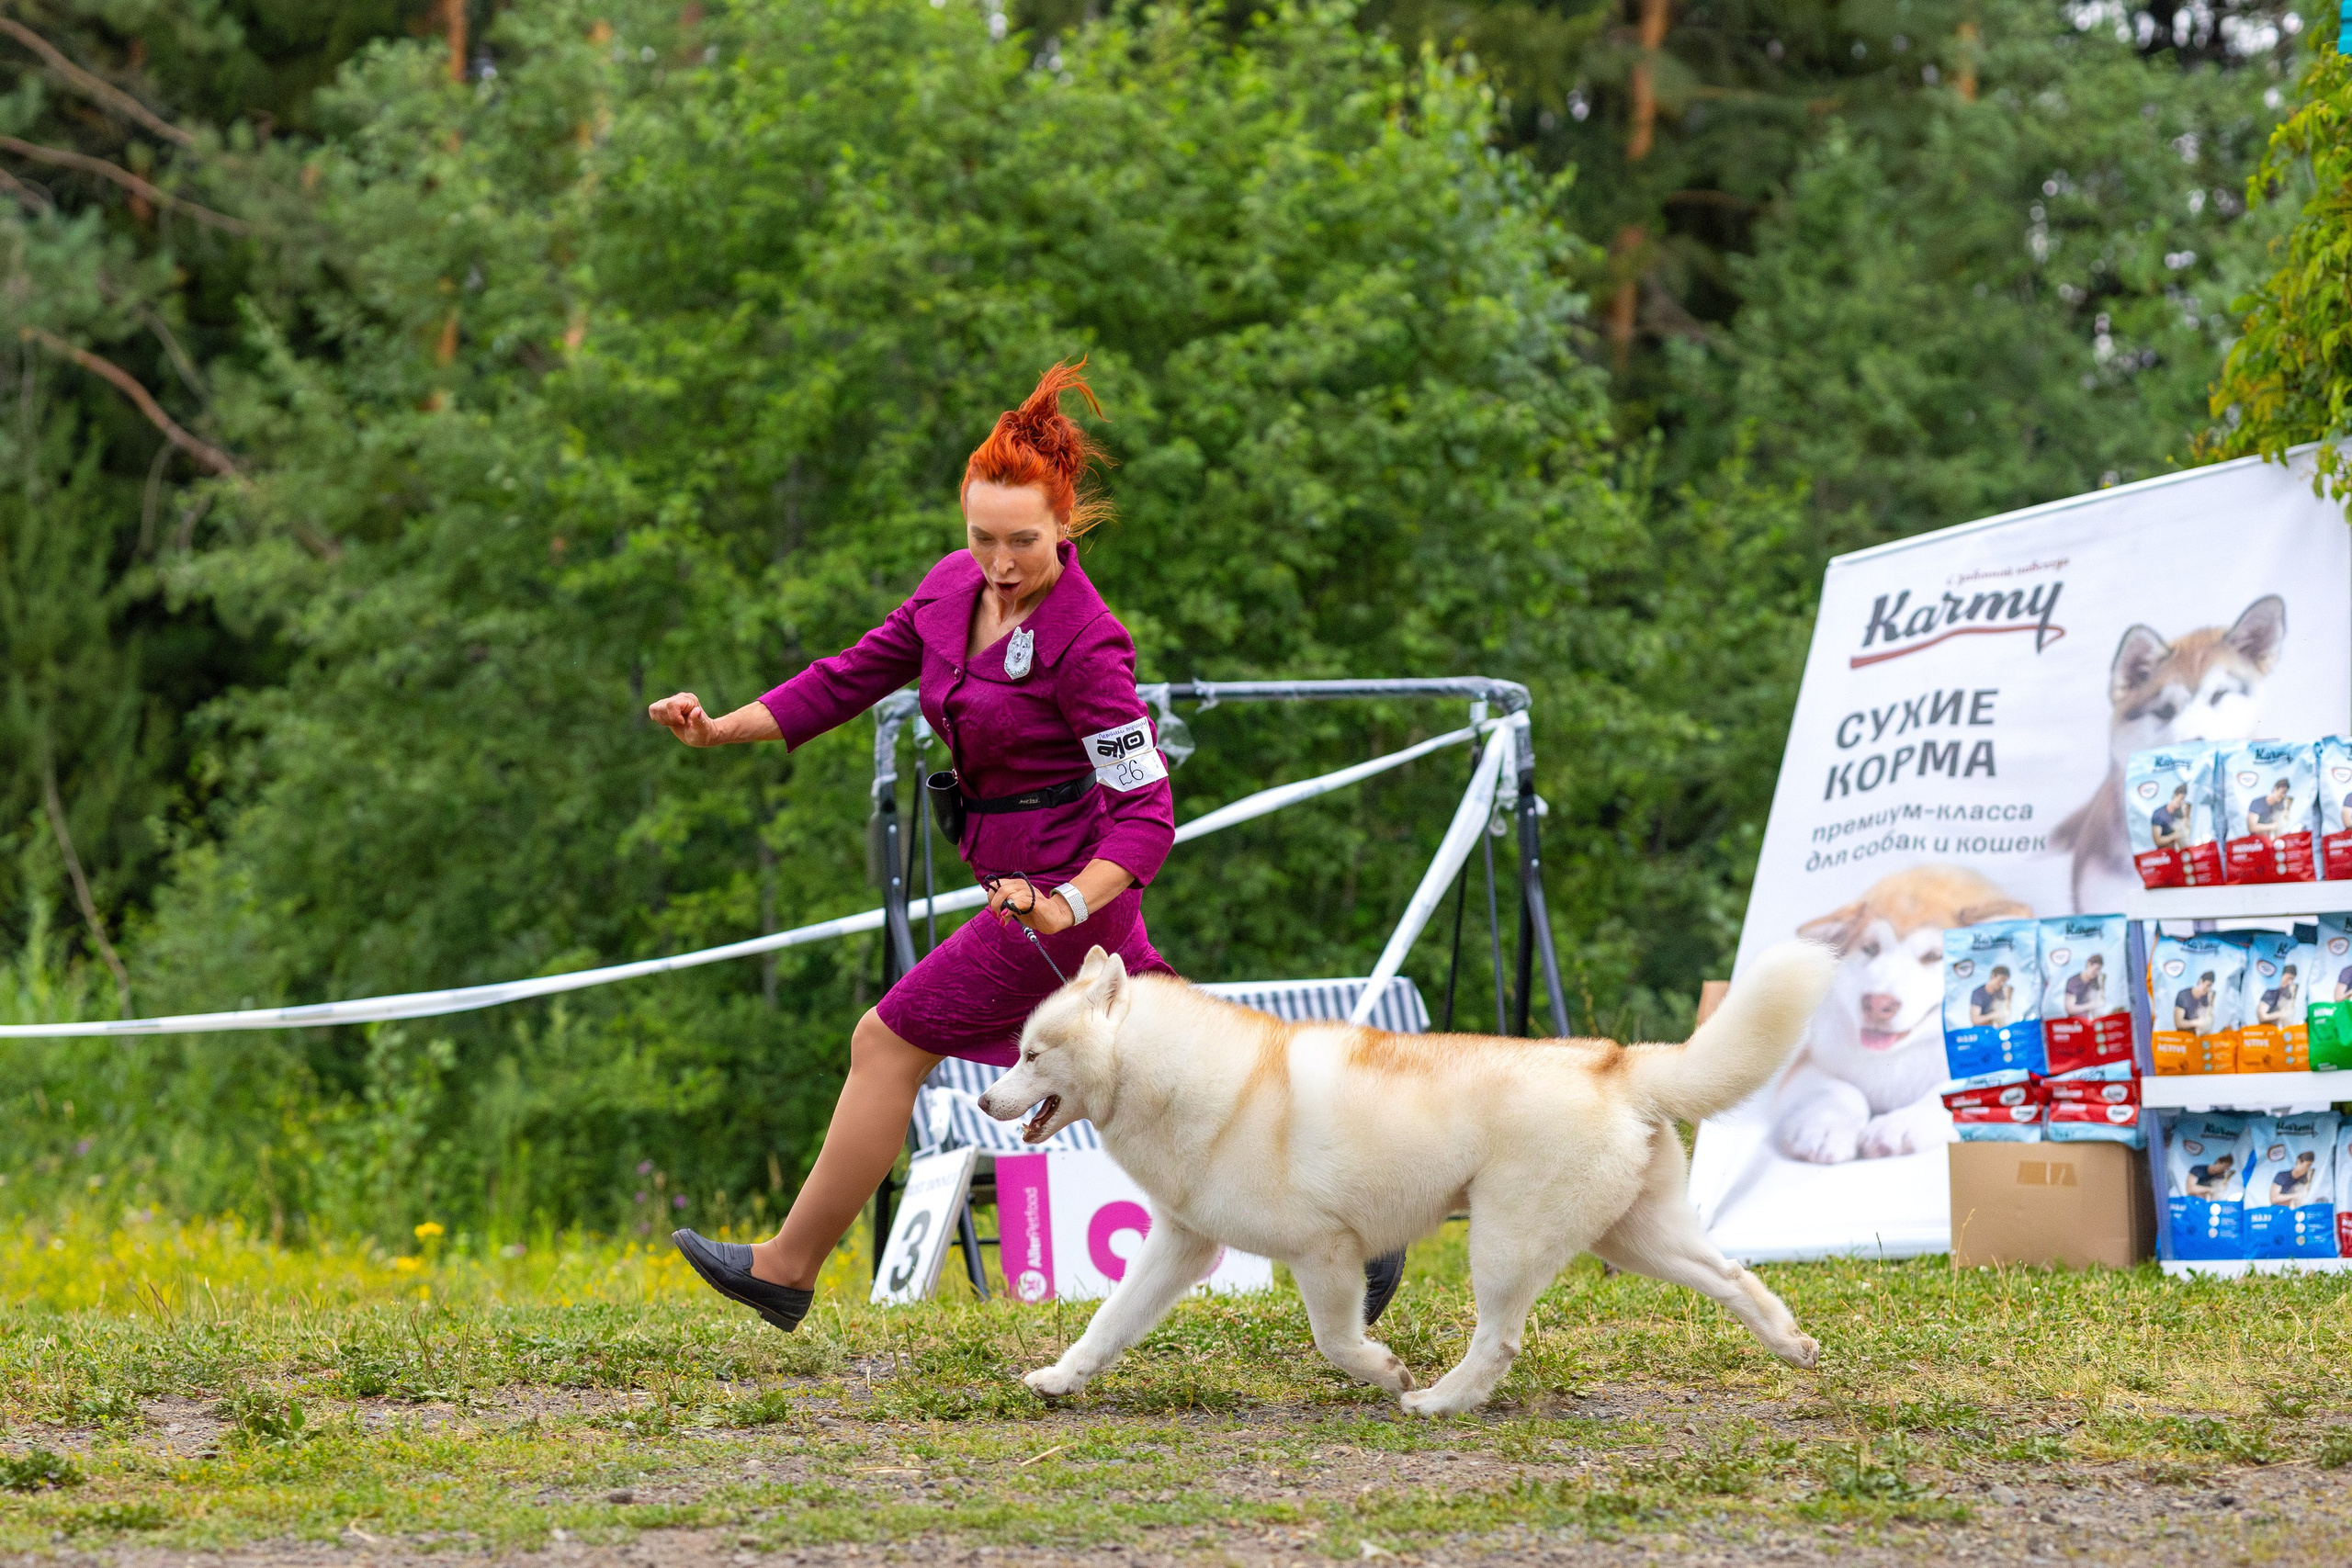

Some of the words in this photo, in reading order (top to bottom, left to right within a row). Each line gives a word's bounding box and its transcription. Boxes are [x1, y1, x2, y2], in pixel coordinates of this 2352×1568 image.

[1861, 581, 2064, 655] Karmy
[1836, 688, 1999, 750] СУХИЕ
[1116, 760, 1144, 785] 26
[1824, 739, 1996, 800] КОРМА
[1811, 803, 2034, 844] премиум-класса
[1852, 829, 1927, 862] собак
[1933, 837, 1949, 853] и
[1956, 835, 2048, 853] кошек
[890, 1209, 932, 1292] 3
